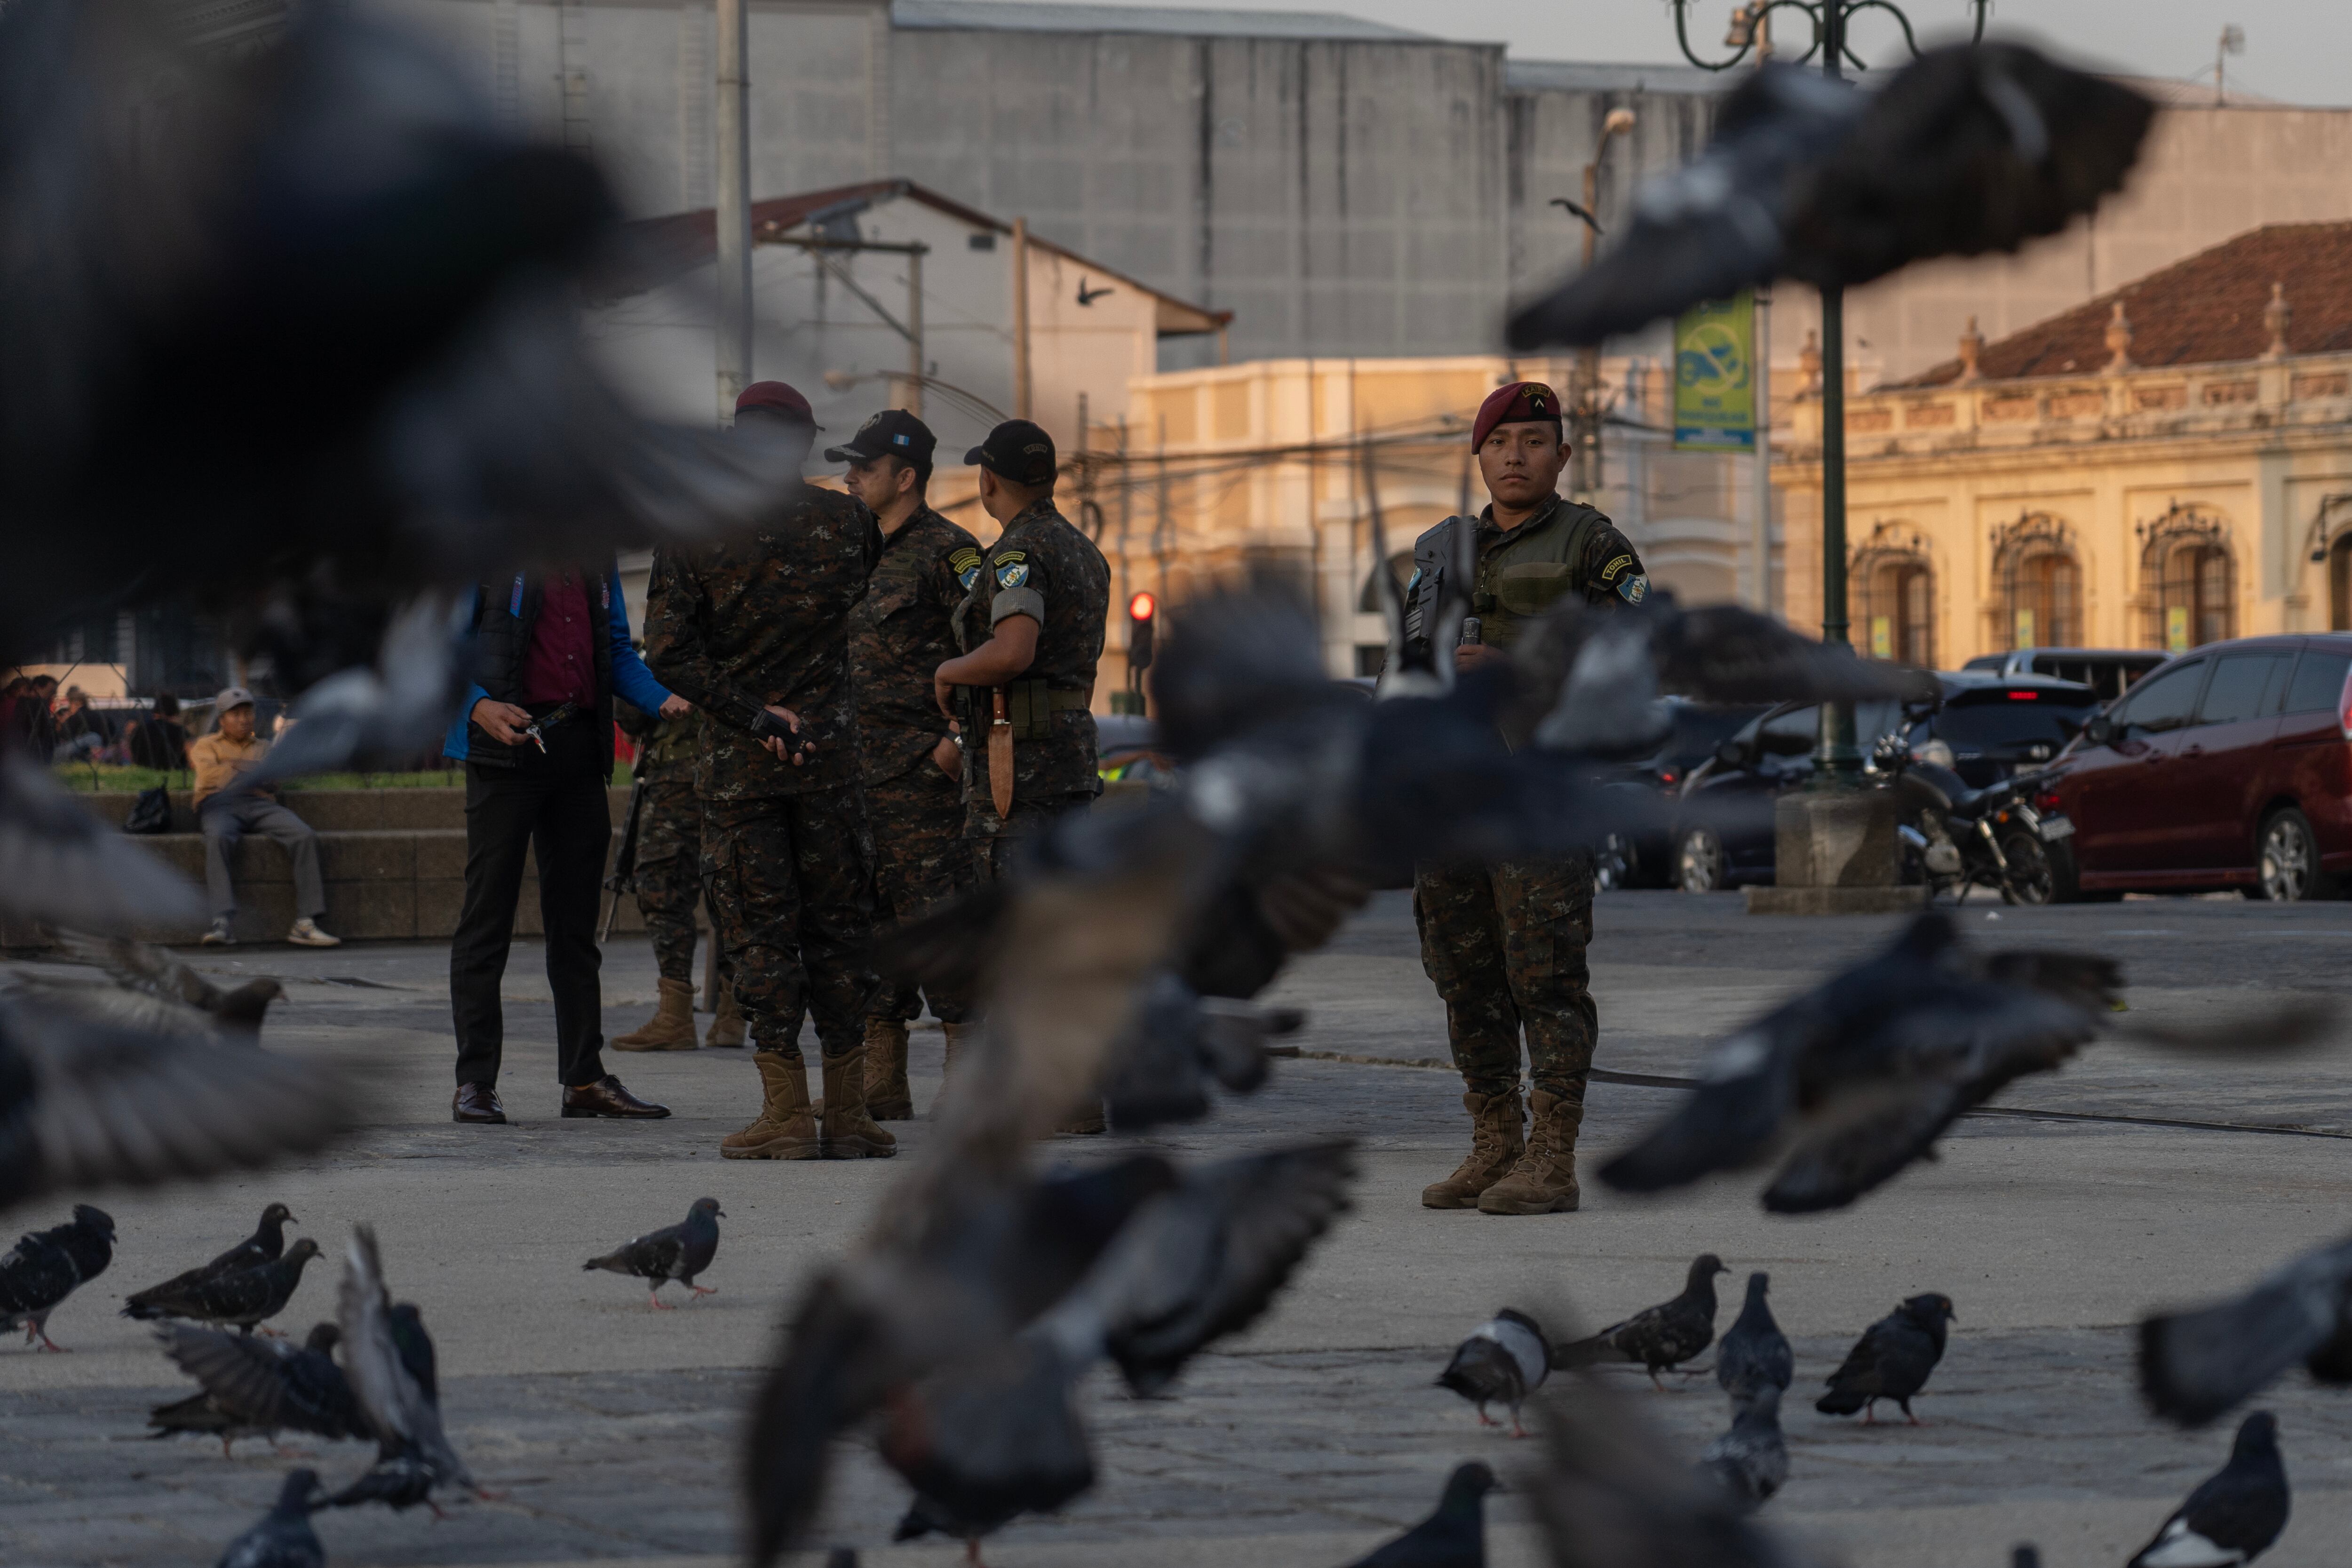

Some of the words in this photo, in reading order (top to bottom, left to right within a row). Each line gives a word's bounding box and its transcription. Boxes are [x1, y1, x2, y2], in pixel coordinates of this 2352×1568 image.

[1525, 385, 1547, 395] KAIBIL
[997, 553, 1021, 563] PARACAIDISTA
[958, 558, 978, 570] BUCEADOR
[1606, 558, 1626, 574] TOHIL
[1626, 578, 1641, 588] GUARDIA
